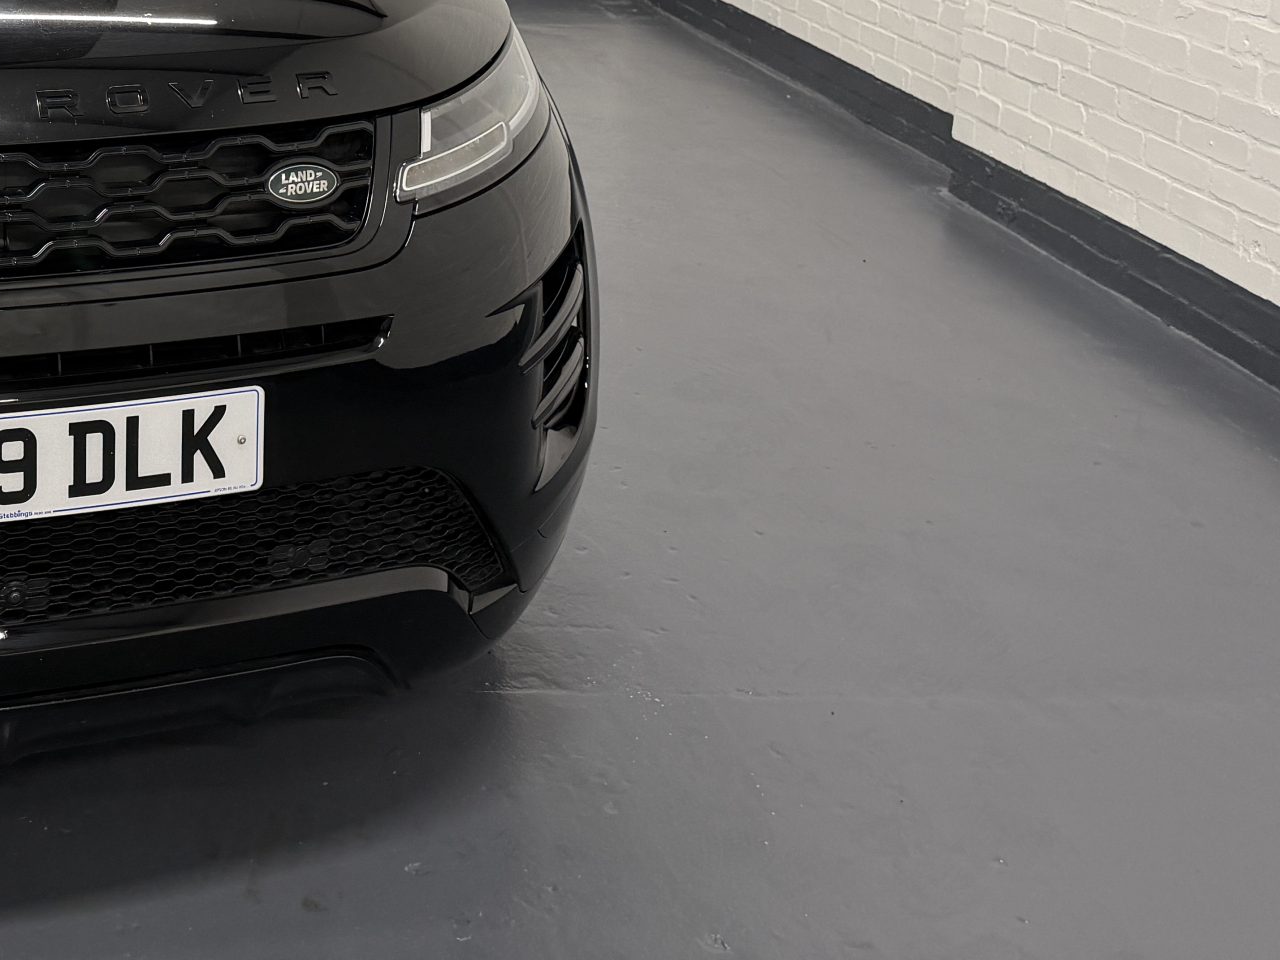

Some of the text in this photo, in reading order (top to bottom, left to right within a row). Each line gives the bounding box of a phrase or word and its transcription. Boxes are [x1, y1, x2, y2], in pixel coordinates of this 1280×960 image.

[35, 71, 338, 119] ROVER
[281, 169, 315, 184] LAND
[287, 180, 328, 196] ROVER
[67, 404, 227, 498] DLK
